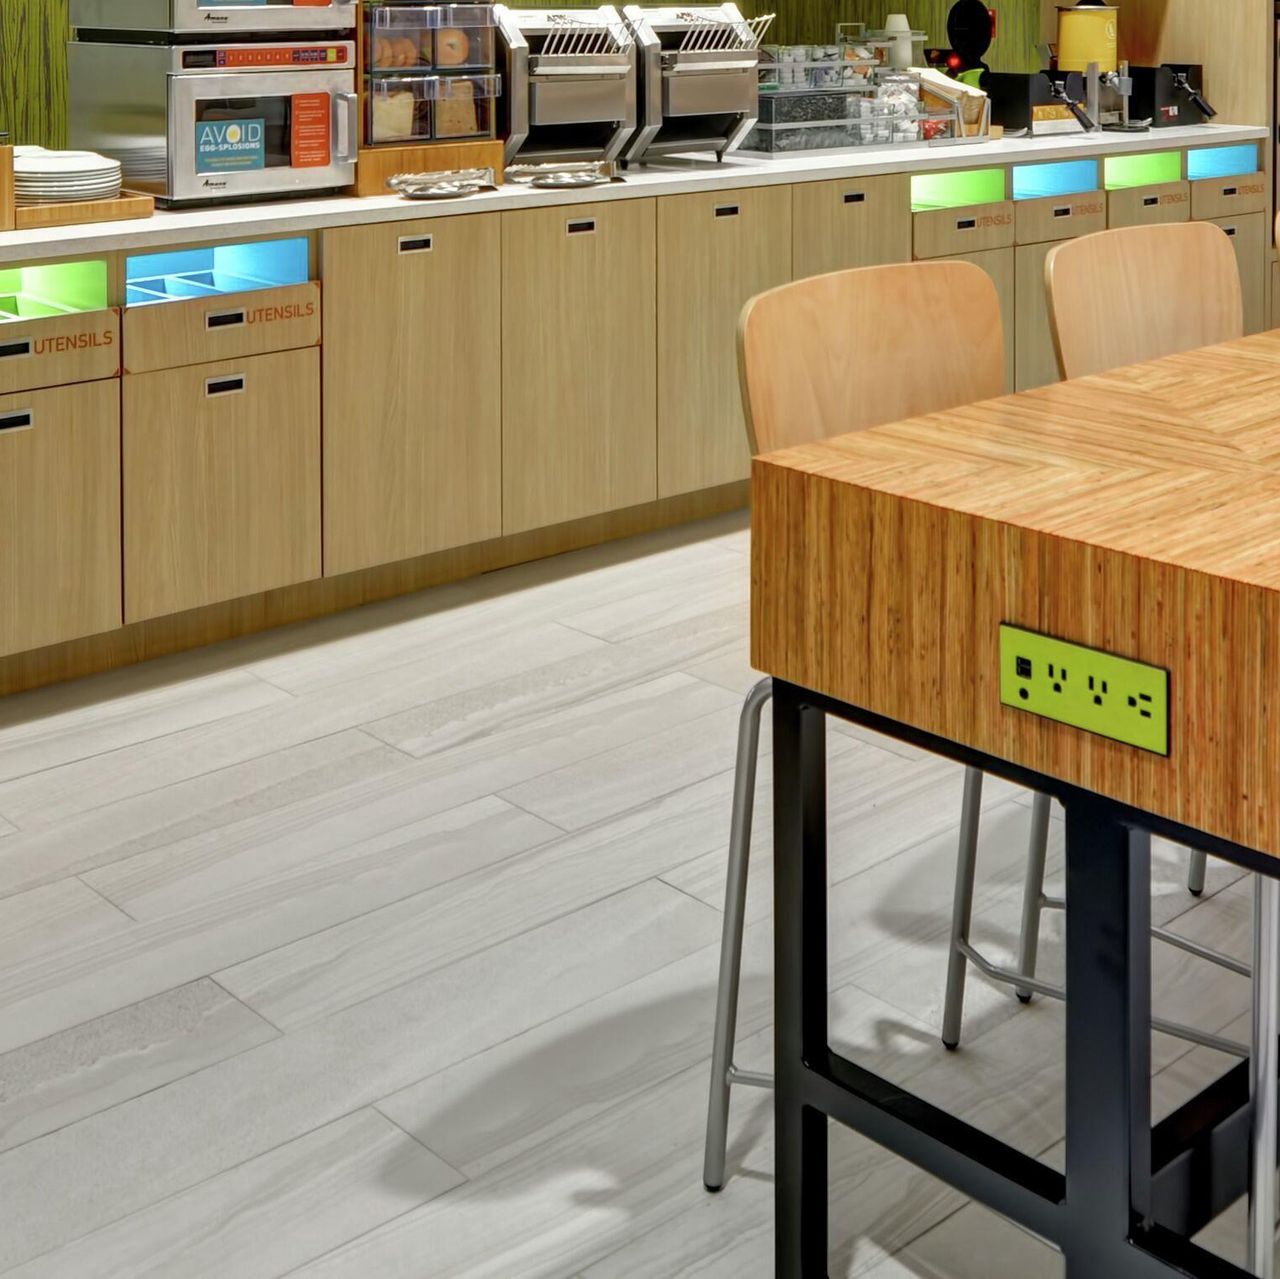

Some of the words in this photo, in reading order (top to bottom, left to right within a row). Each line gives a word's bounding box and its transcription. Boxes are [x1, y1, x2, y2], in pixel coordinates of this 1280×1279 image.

[200, 124, 261, 144] AVOID
[200, 142, 260, 153] EGG-SPLOSIONS
[246, 303, 314, 324] UTENSILS
[33, 330, 112, 354] UTENSILS
